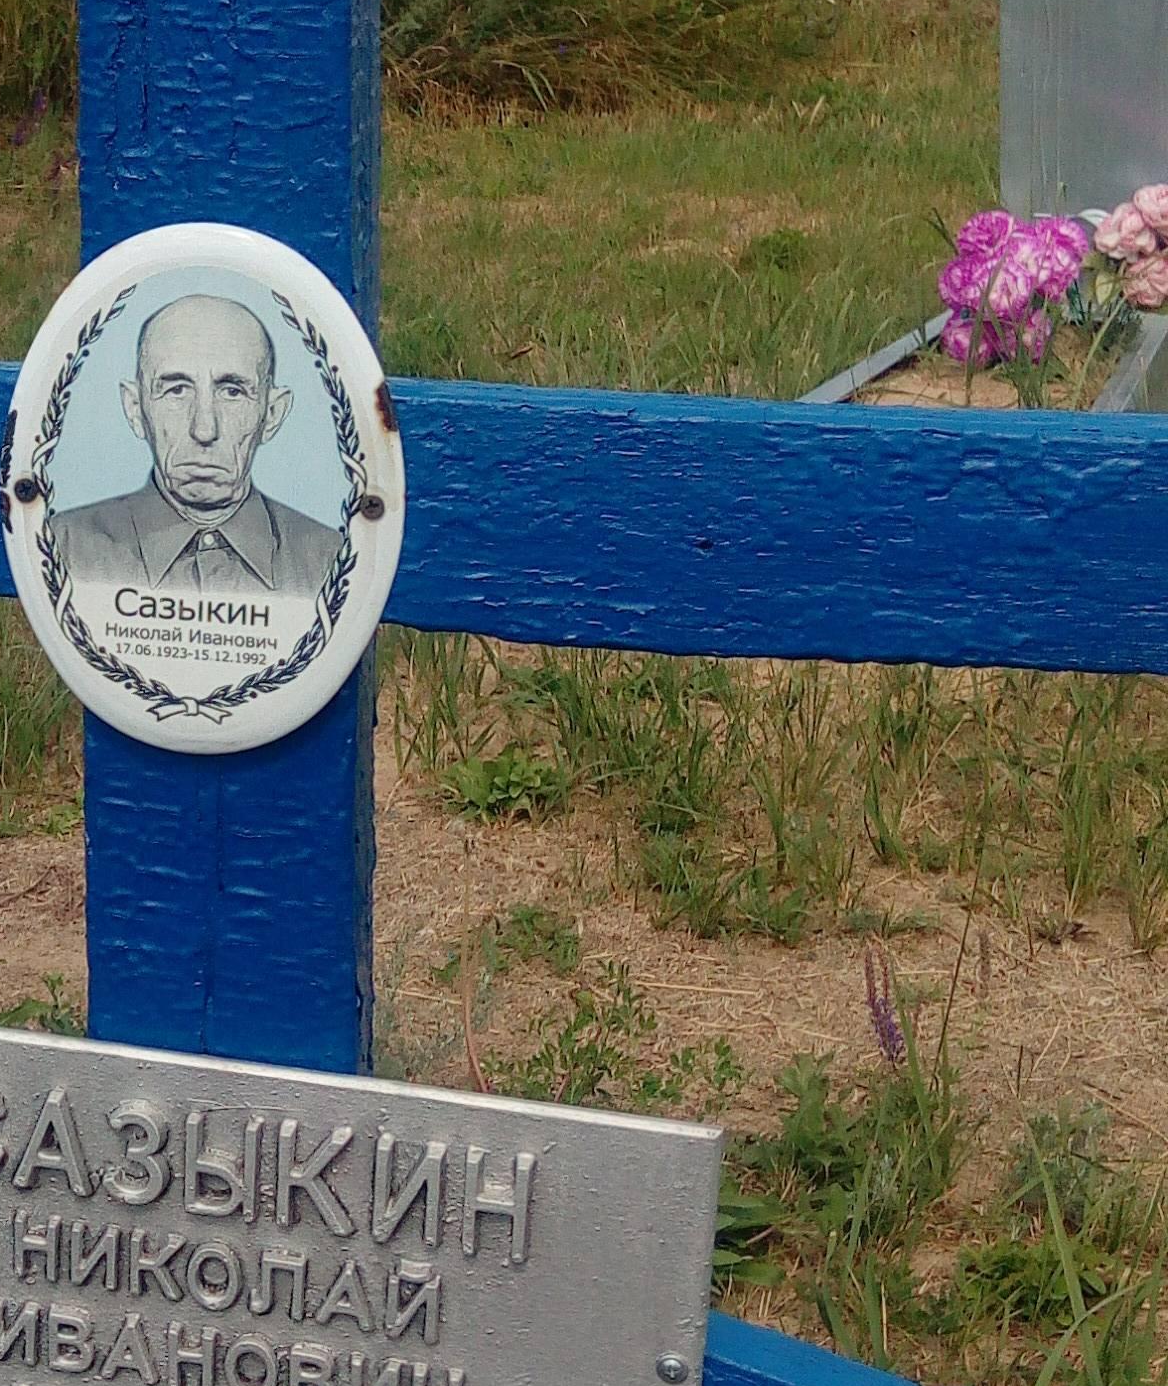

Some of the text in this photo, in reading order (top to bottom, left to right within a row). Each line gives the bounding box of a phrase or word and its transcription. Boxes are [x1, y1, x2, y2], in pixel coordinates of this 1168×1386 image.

[114, 587, 269, 626] Сазыкин
[105, 622, 278, 651] Николай Иванович
[12, 1208, 442, 1346] НИКОЛАЙ
